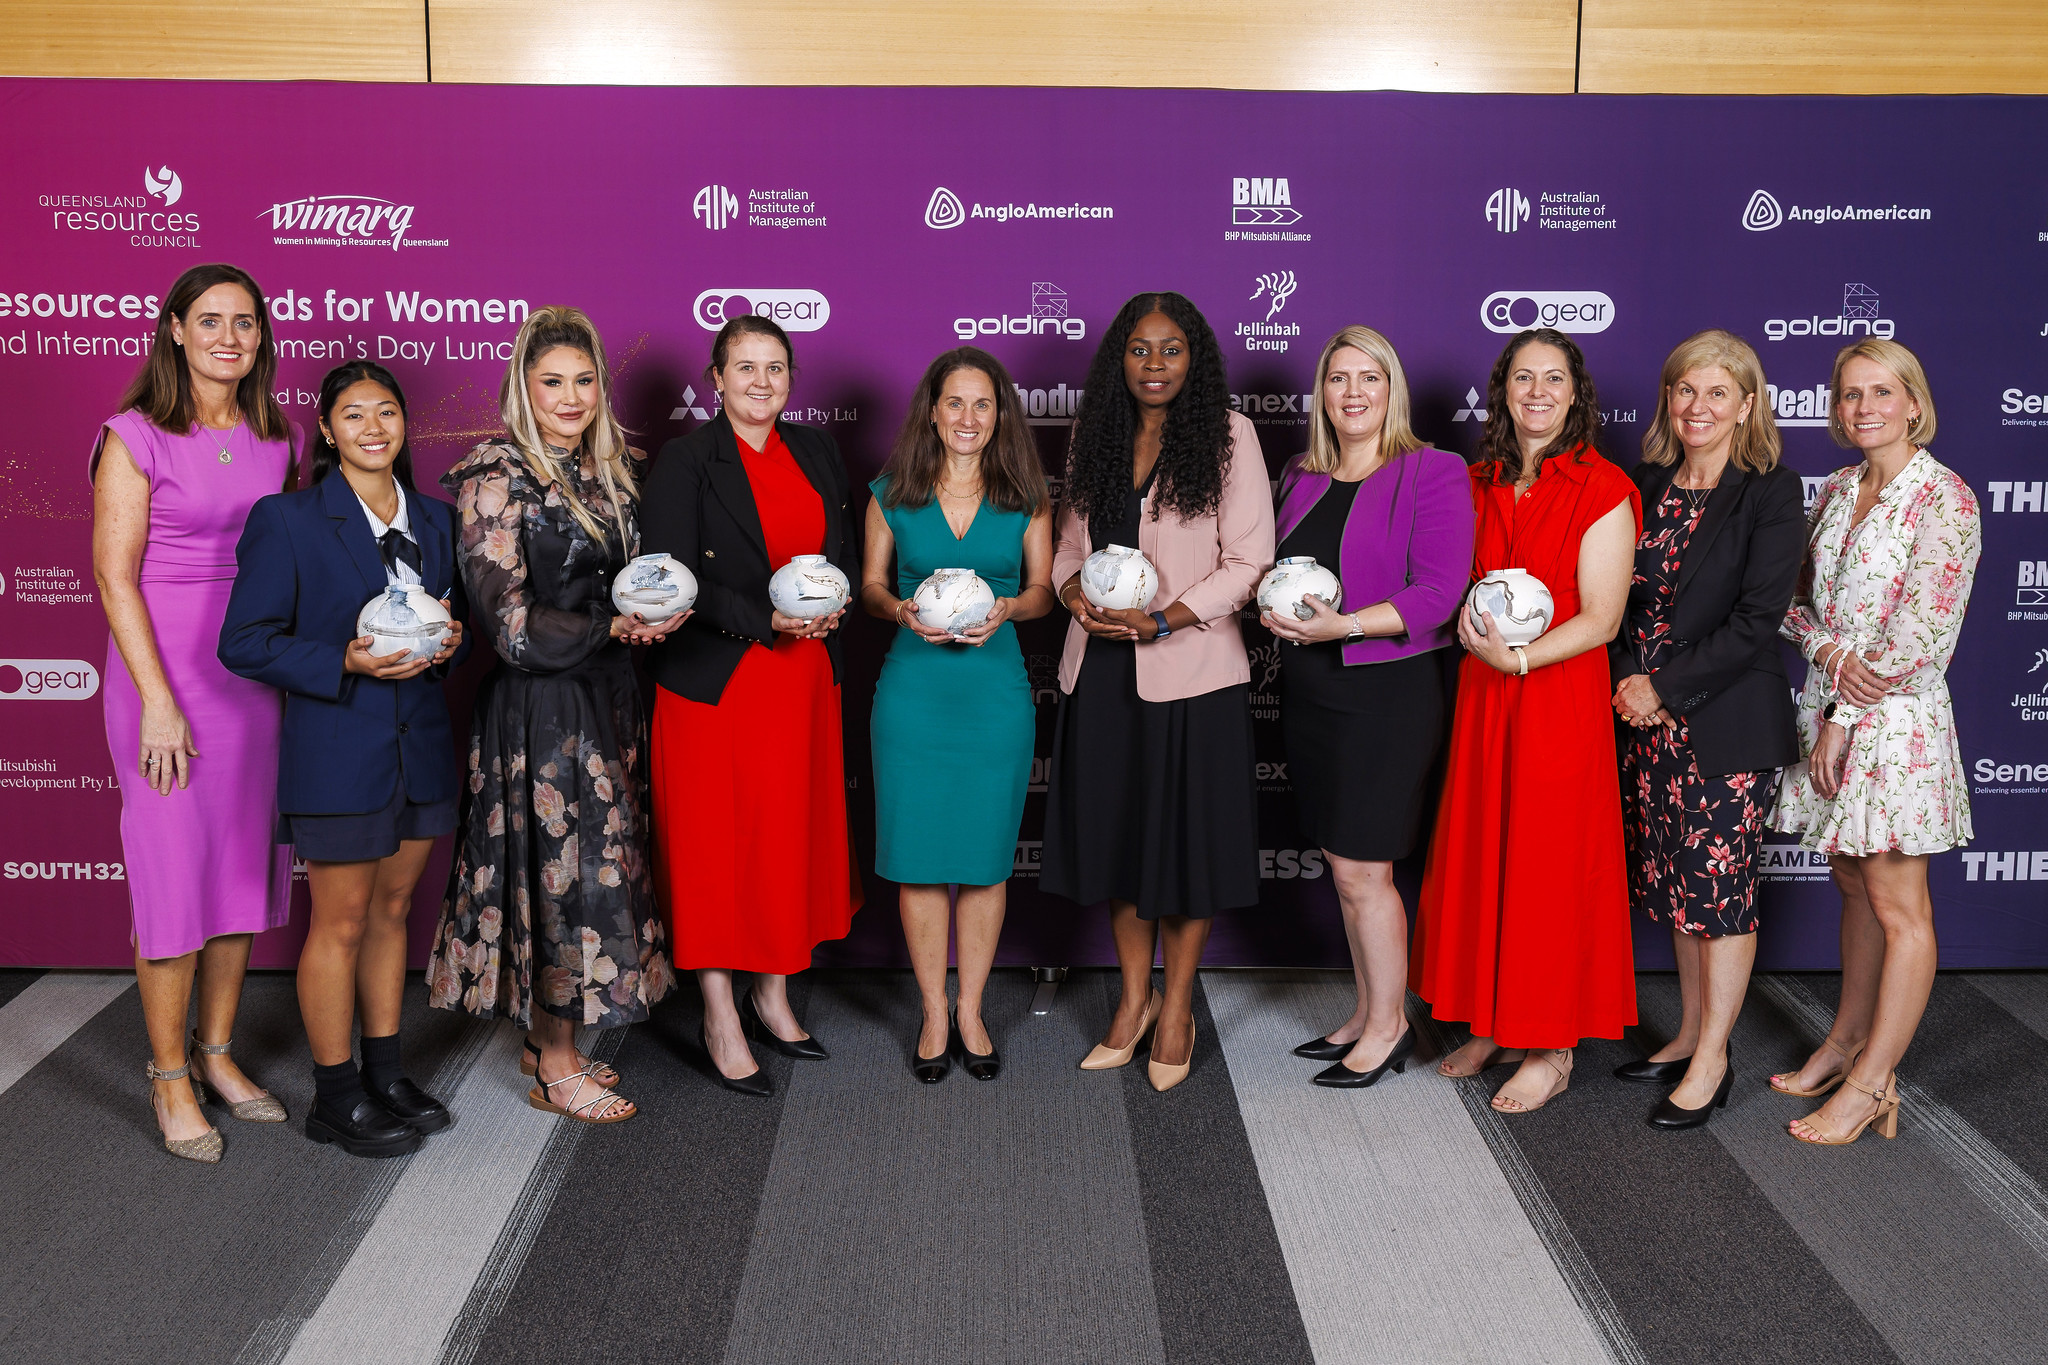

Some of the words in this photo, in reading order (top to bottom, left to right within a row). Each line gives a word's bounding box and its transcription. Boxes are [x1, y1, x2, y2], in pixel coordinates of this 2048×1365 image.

[748, 188, 809, 200] Australian
[1233, 177, 1291, 205] BMA
[1540, 191, 1600, 203] Australian
[38, 194, 147, 208] QUEENSLAND
[693, 184, 739, 230] AIM
[749, 202, 800, 213] Institute
[803, 201, 815, 213] of
[970, 203, 1114, 222] AngloAmerican
[1485, 187, 1531, 232] AIM
[1540, 205, 1590, 216] Institute
[1593, 204, 1606, 216] of
[1788, 204, 1931, 225] AngloAmerican
[54, 210, 200, 232] resources
[272, 196, 415, 252] wimarq
[749, 215, 827, 229] Management
[1540, 218, 1617, 232] Management
[130, 235, 201, 248] COUNCIL
[273, 237, 304, 245] Women
[305, 237, 313, 245] in
[313, 238, 341, 247] Mining
[348, 238, 391, 246] Resources
[402, 239, 449, 247] Queensland
[1224, 231, 1240, 241] BHP
[1241, 231, 1280, 241] Mitsubishi
[1281, 232, 1312, 242] Alliance
[325, 289, 374, 322] for
[386, 291, 529, 323] Women
[953, 314, 1086, 340] golding
[1234, 322, 1300, 336] Jellinbah
[1764, 315, 1896, 341] golding
[378, 335, 436, 366] Day
[445, 336, 518, 360] Lunc
[1245, 337, 1288, 353] Group
[297, 388, 322, 409] by
[807, 408, 830, 425] Pty
[834, 408, 857, 421] Ltd
[1613, 409, 1636, 422] Ltd
[2002, 419, 2037, 427] Delivering
[14, 566, 74, 577] Australian
[15, 579, 66, 590] Institute
[68, 579, 81, 590] of
[16, 592, 93, 605] Management
[2007, 611, 2023, 621] BHP
[0, 759, 57, 772] itsubishi
[0, 775, 77, 791] evelopment
[80, 775, 104, 792] Pty
[1974, 787, 2009, 795] Delivering
[3, 861, 125, 880] SOUTH32
